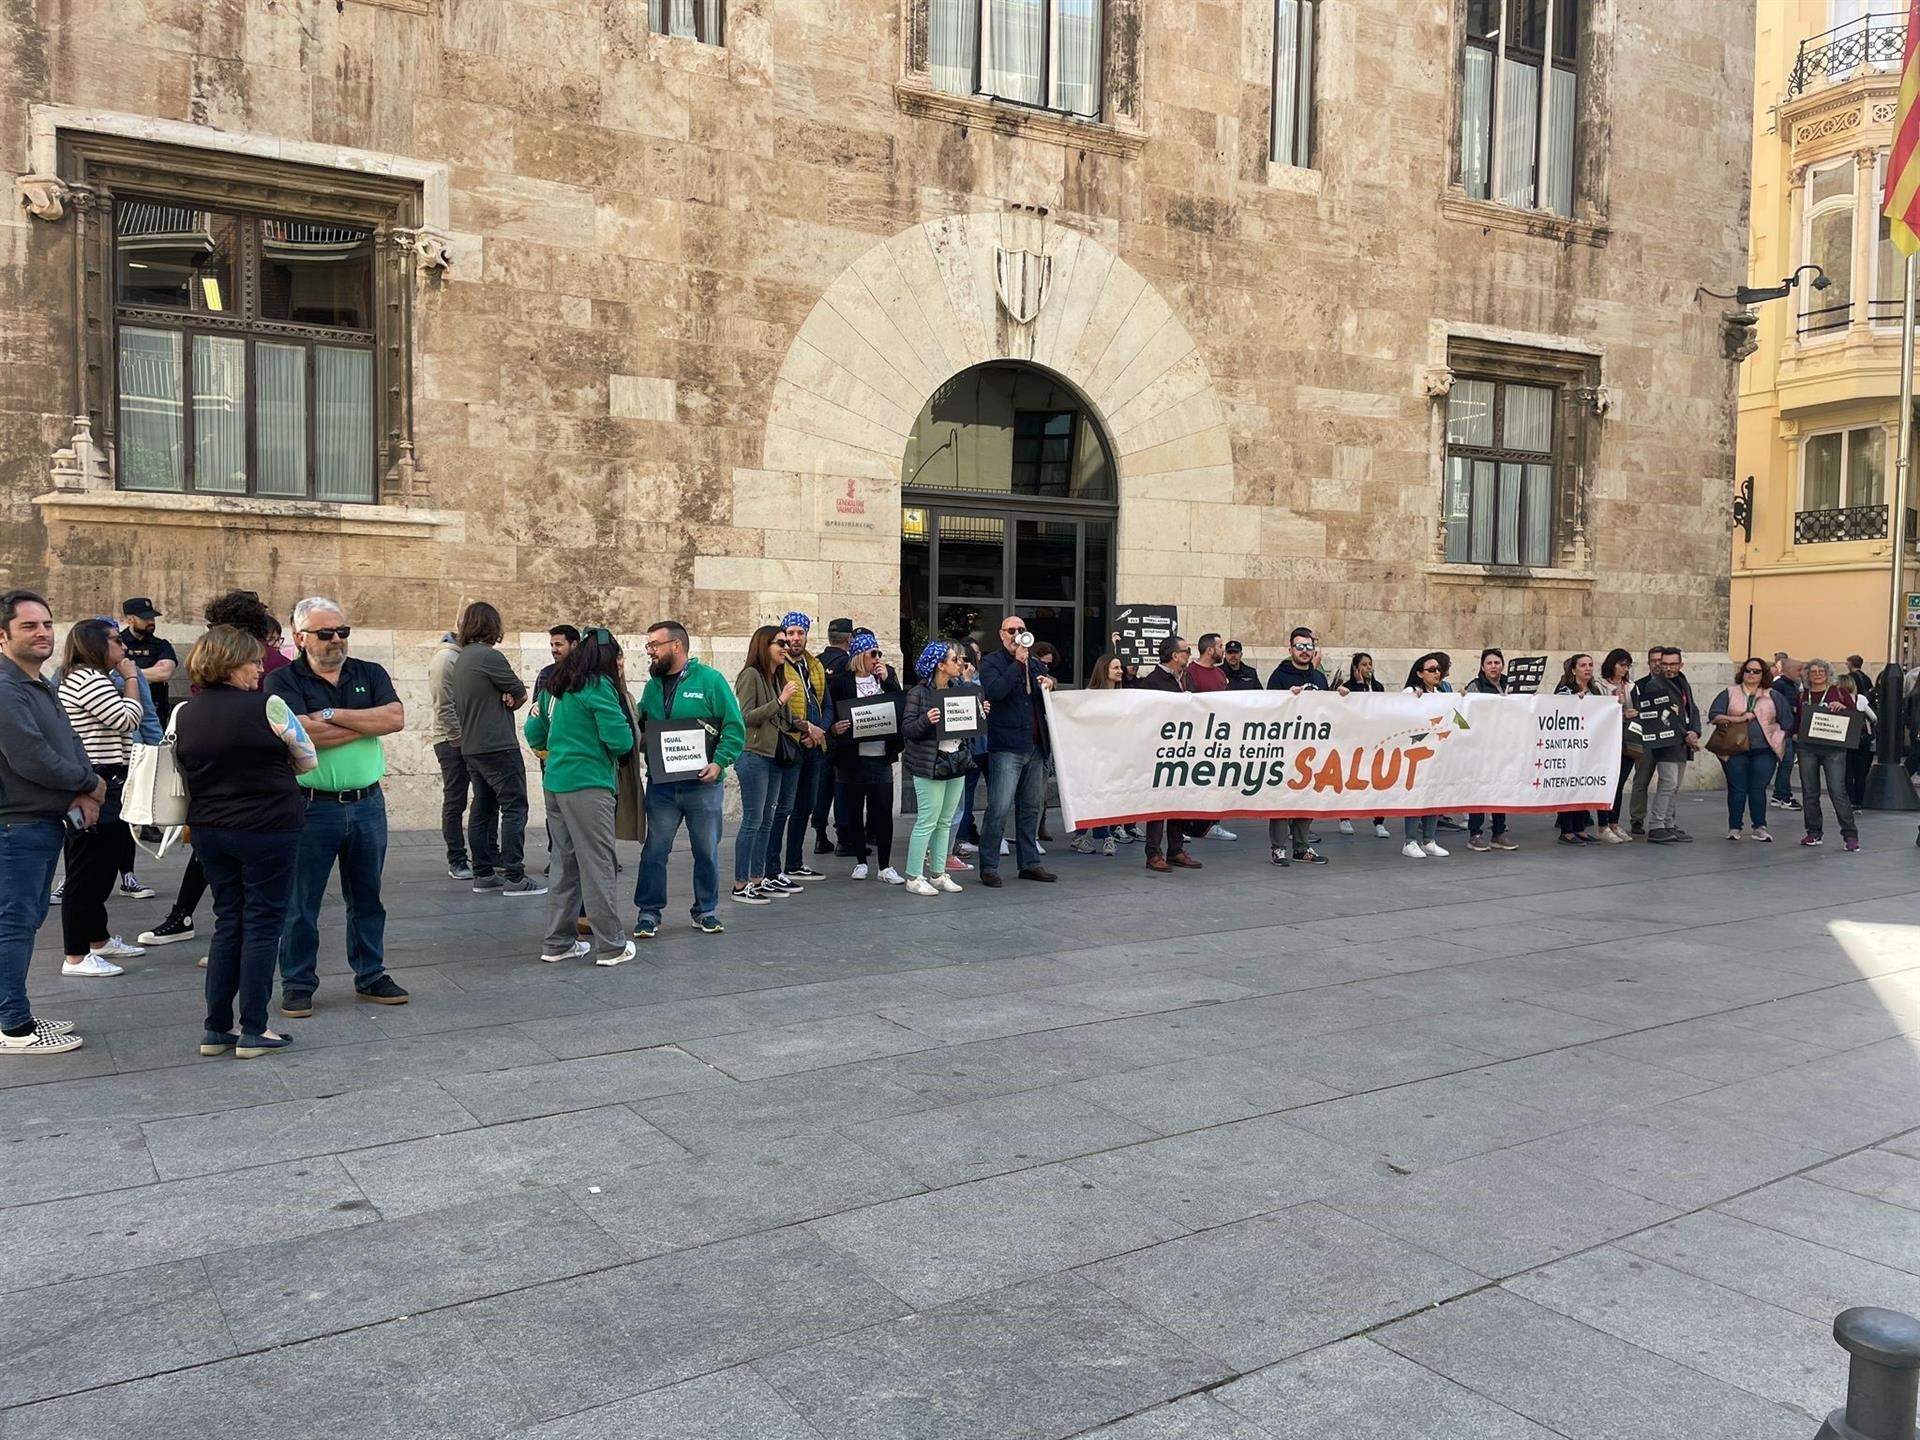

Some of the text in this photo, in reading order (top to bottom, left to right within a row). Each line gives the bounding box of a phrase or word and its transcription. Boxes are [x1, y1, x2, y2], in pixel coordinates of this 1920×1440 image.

[856, 721, 892, 730] CONDICIONS
[1538, 709, 1584, 730] volem:
[1160, 713, 1332, 740] en la marina
[1156, 741, 1284, 758] cada dia tenim
[1545, 738, 1589, 749] SANITARIS
[666, 753, 702, 761] CONDICIONS
[1544, 758, 1567, 769] CITES
[1152, 746, 1434, 796] menys SALUT
[1543, 776, 1607, 789] INTERVENCIONS
